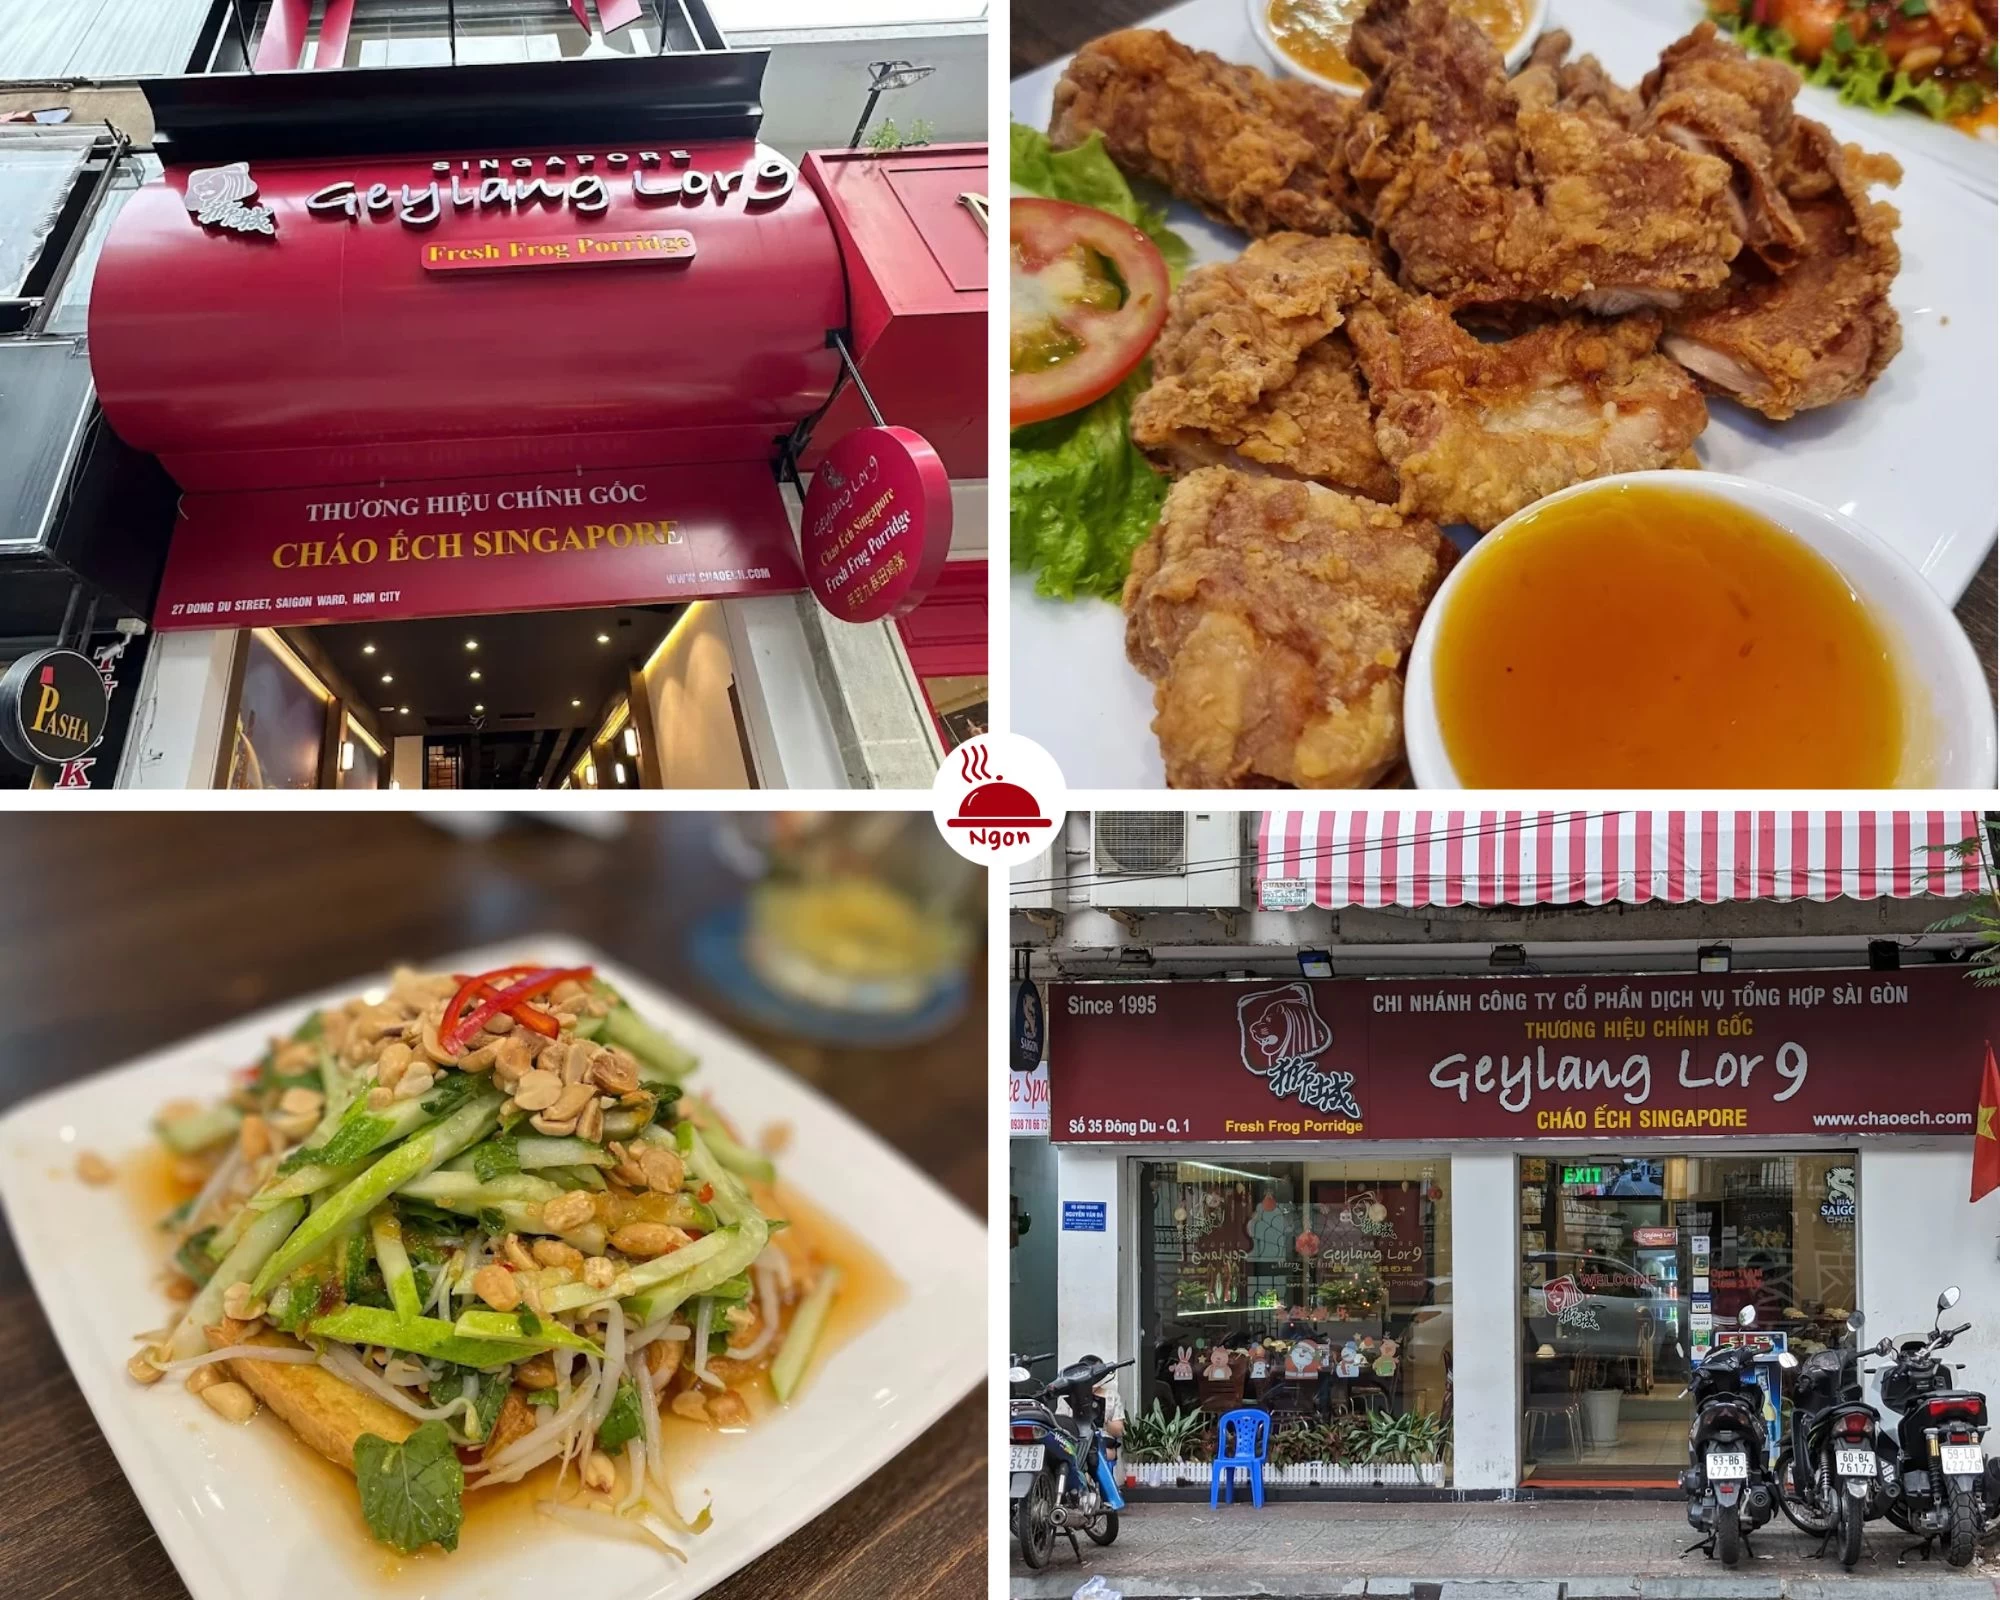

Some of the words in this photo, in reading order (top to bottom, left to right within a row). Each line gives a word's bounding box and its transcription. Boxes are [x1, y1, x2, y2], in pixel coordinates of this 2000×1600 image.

[432, 150, 692, 171] SINGAPORE
[305, 174, 609, 224] Geylang
[429, 244, 500, 262] Fresh
[508, 241, 571, 259] Frog
[577, 234, 691, 255] Porridge
[306, 497, 420, 522] THƯƠNG
[427, 491, 490, 517] HIỆU
[497, 484, 584, 511] CHÍNH
[589, 480, 648, 505] GỐC
[853, 488, 895, 535] Singapore
[272, 532, 379, 569] CHÁO
[388, 528, 463, 562] ẾCH
[473, 519, 684, 558] SINGAPORE
[825, 567, 850, 594] Fresh
[847, 549, 871, 575] Frog
[868, 509, 912, 555] Porridge
[171, 604, 184, 615] 27
[186, 602, 214, 614] DONG
[217, 601, 231, 612] DU
[235, 598, 272, 611] STREET,
[275, 596, 313, 608] SAIGON
[317, 594, 348, 607] WARD,
[353, 592, 375, 604] HCM
[379, 591, 401, 603] CITY
[30, 684, 89, 743] PASHA
[1068, 995, 1114, 1015] Since
[1119, 995, 1157, 1015] 1995
[1372, 994, 1402, 1012] CHI
[1410, 990, 1472, 1012] NHÁNH
[1479, 988, 1527, 1011] CÔNG
[1534, 992, 1557, 1011] TY
[1564, 983, 1587, 1010] CỔ
[1594, 984, 1643, 1009] PHẦN
[1651, 990, 1693, 1012] DỊCH
[1701, 988, 1725, 1011] VỤ
[1732, 980, 1781, 1006] TỔNG
[1788, 984, 1826, 1009] HỢP
[1833, 983, 1862, 1005] SÀI
[1870, 982, 1909, 1004] GÒN
[1524, 1018, 1596, 1040] THƯƠNG
[1604, 1016, 1646, 1041] HIỆU
[1653, 1015, 1709, 1038] CHÍNH
[1717, 1010, 1754, 1037] GỐC
[1024, 1071, 1048, 1110] Spa
[1429, 1045, 1651, 1113] Geylang
[1678, 1049, 1764, 1088] Lor
[1773, 1041, 1808, 1102] 9
[1069, 1116, 1086, 1133] Số
[1088, 1119, 1102, 1133] 35
[1105, 1119, 1137, 1136] Đông
[1140, 1119, 1157, 1133] Du
[1183, 1118, 1190, 1133] 1
[1225, 1119, 1265, 1133] Fresh
[1268, 1119, 1301, 1136] Frog
[1304, 1119, 1363, 1135] Porridge
[1536, 1106, 1587, 1130] CHÁO
[1594, 1104, 1632, 1129] ẾCH
[1639, 1108, 1748, 1128] SINGAPORE
[1813, 1110, 1972, 1126] www.chaoech.com
[1563, 1168, 1602, 1183] EXIT
[1323, 1247, 1382, 1264] Geylang
[1387, 1249, 1411, 1260] Lor
[1412, 1246, 1423, 1262] 9
[1391, 1279, 1424, 1287] Porridge
[1580, 1273, 1657, 1288] WELCOME
